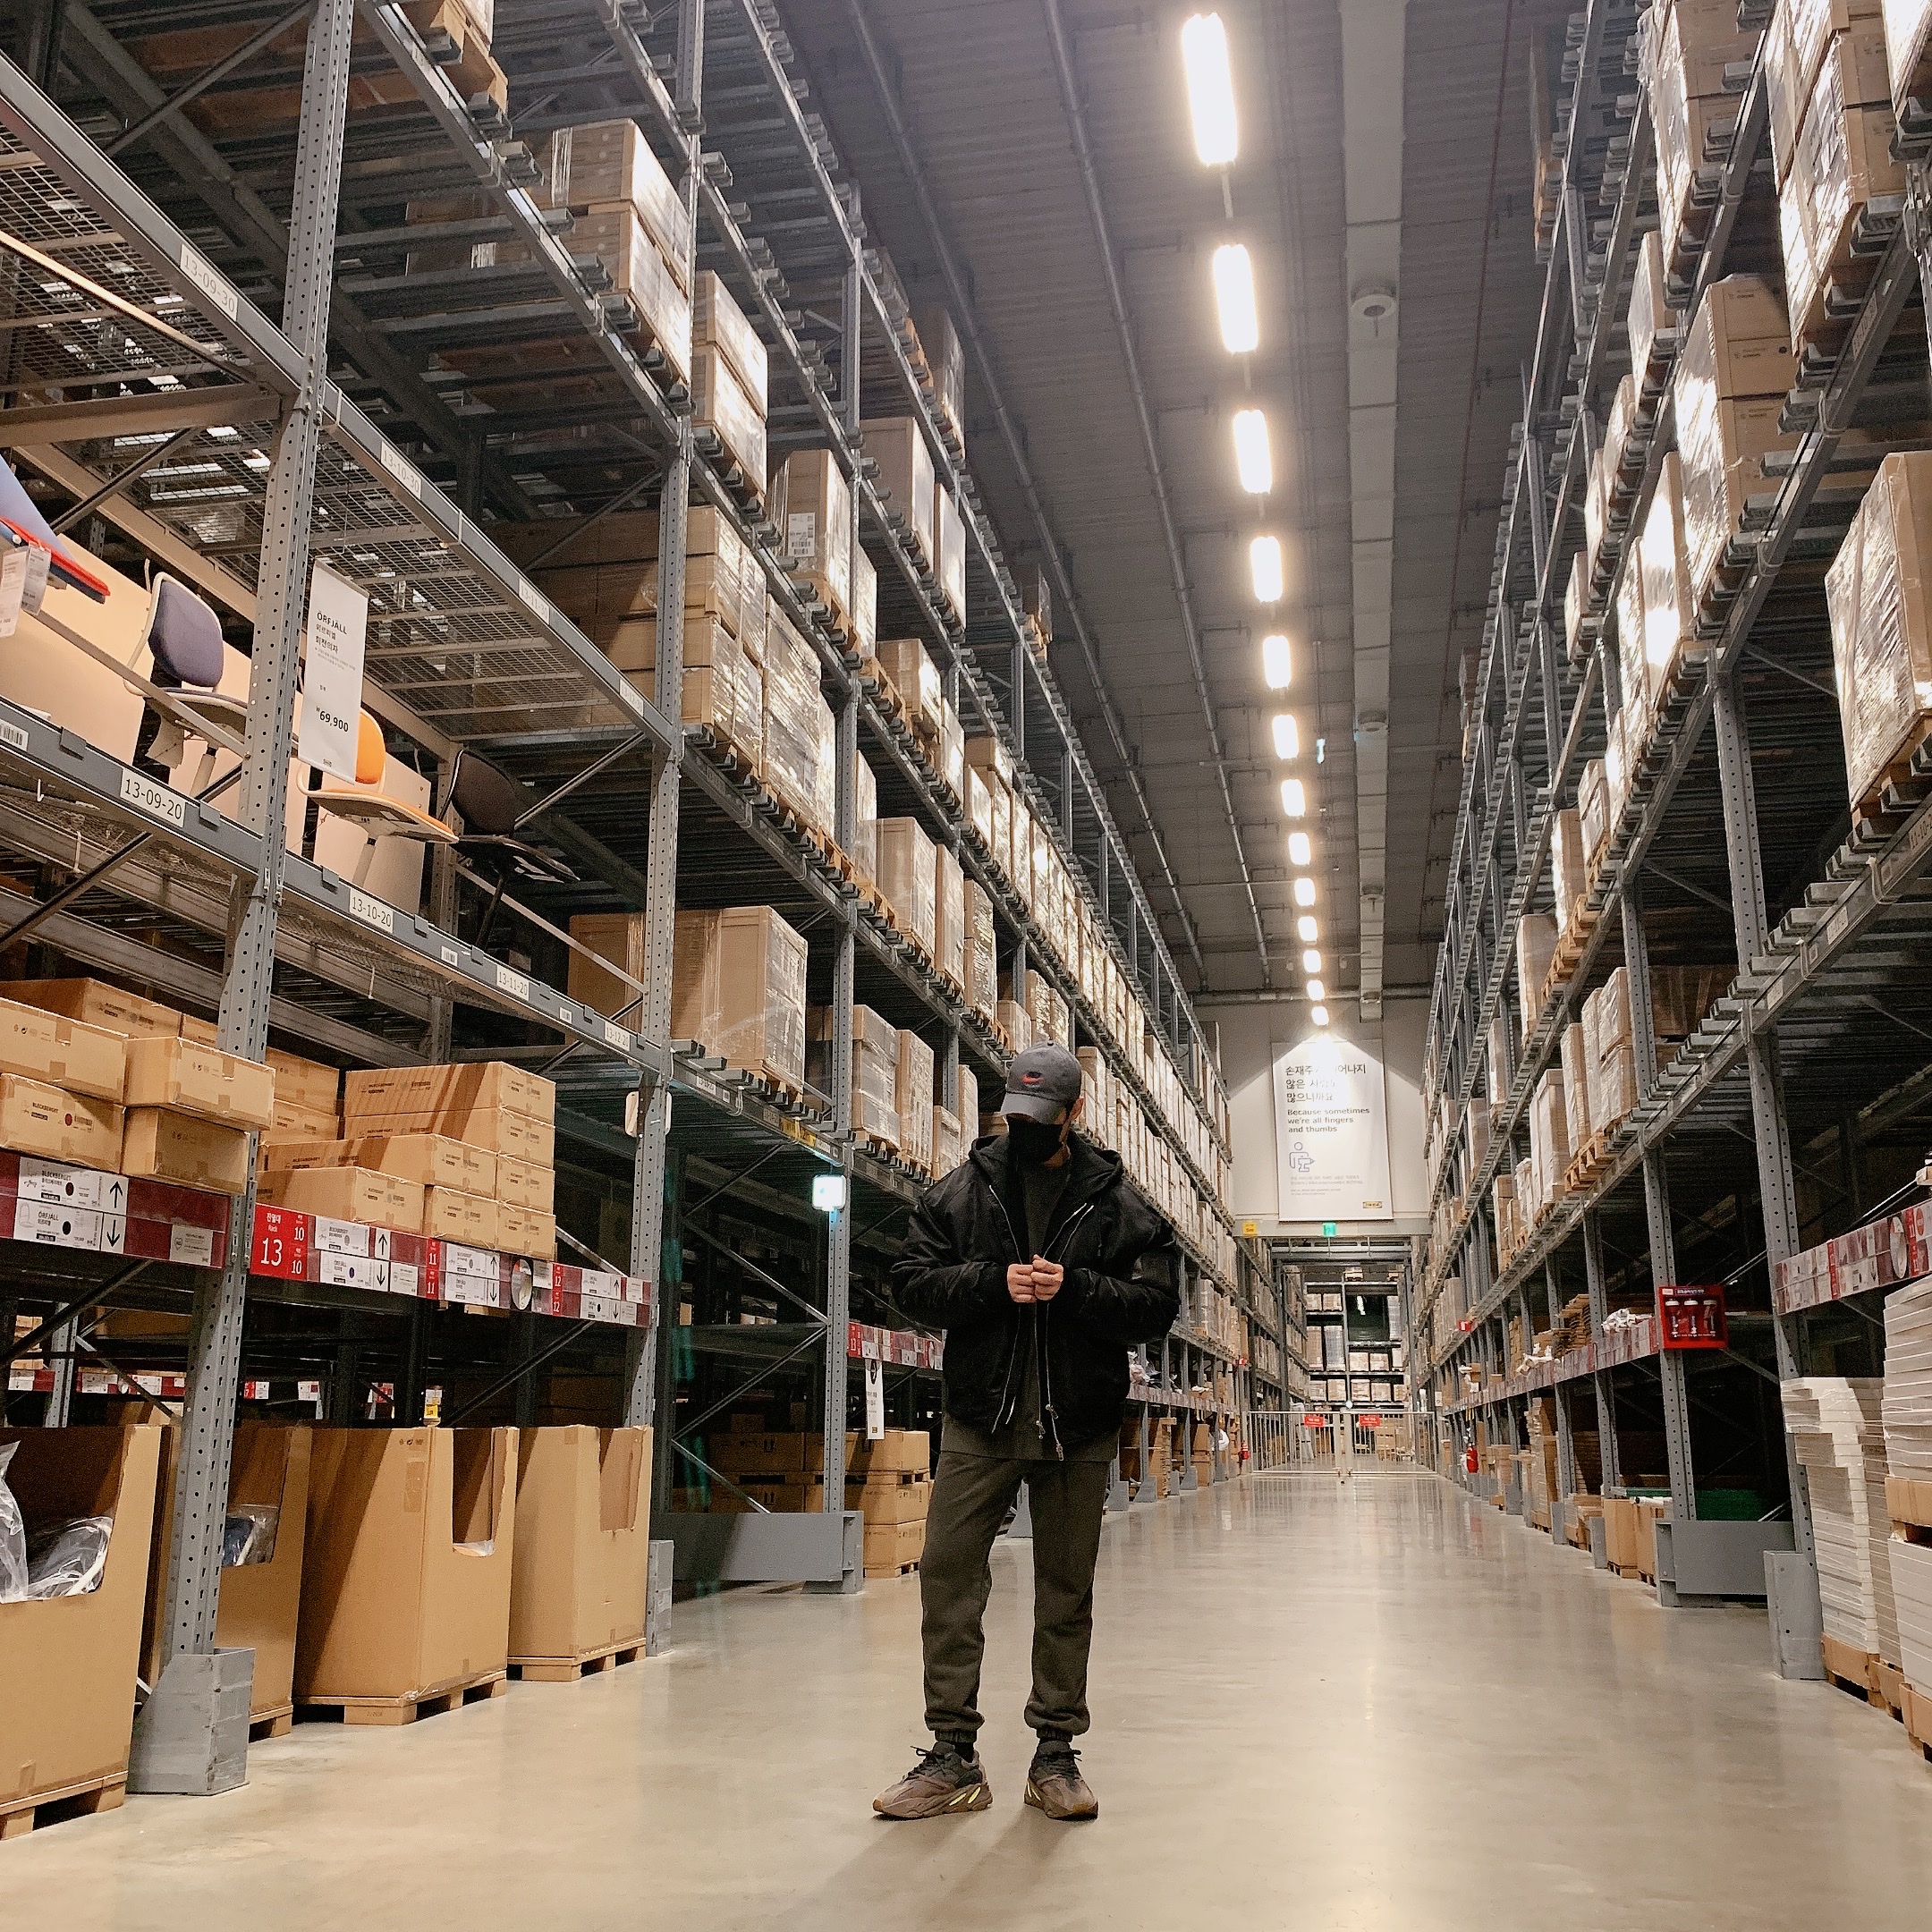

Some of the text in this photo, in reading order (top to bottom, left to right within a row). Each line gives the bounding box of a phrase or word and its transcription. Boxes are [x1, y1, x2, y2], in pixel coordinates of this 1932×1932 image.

[184, 255, 235, 313] 13-09-30
[383, 450, 419, 493] 13-10-30
[317, 610, 348, 635] ÖRFJÄLL
[124, 778, 182, 820] 13-09-20
[352, 896, 392, 928] 13-10-20
[498, 970, 528, 996] 13-11-20
[1287, 1107, 1370, 1116] Because sometimes
[1325, 1117, 1354, 1125] fingers
[294, 1226, 305, 1241] 10
[260, 1237, 283, 1267] 13
[428, 1252, 437, 1266] 11
[291, 1259, 302, 1275] 10
[427, 1281, 436, 1295] 11
[554, 1275, 562, 1287] 12
[553, 1302, 560, 1313] 12
